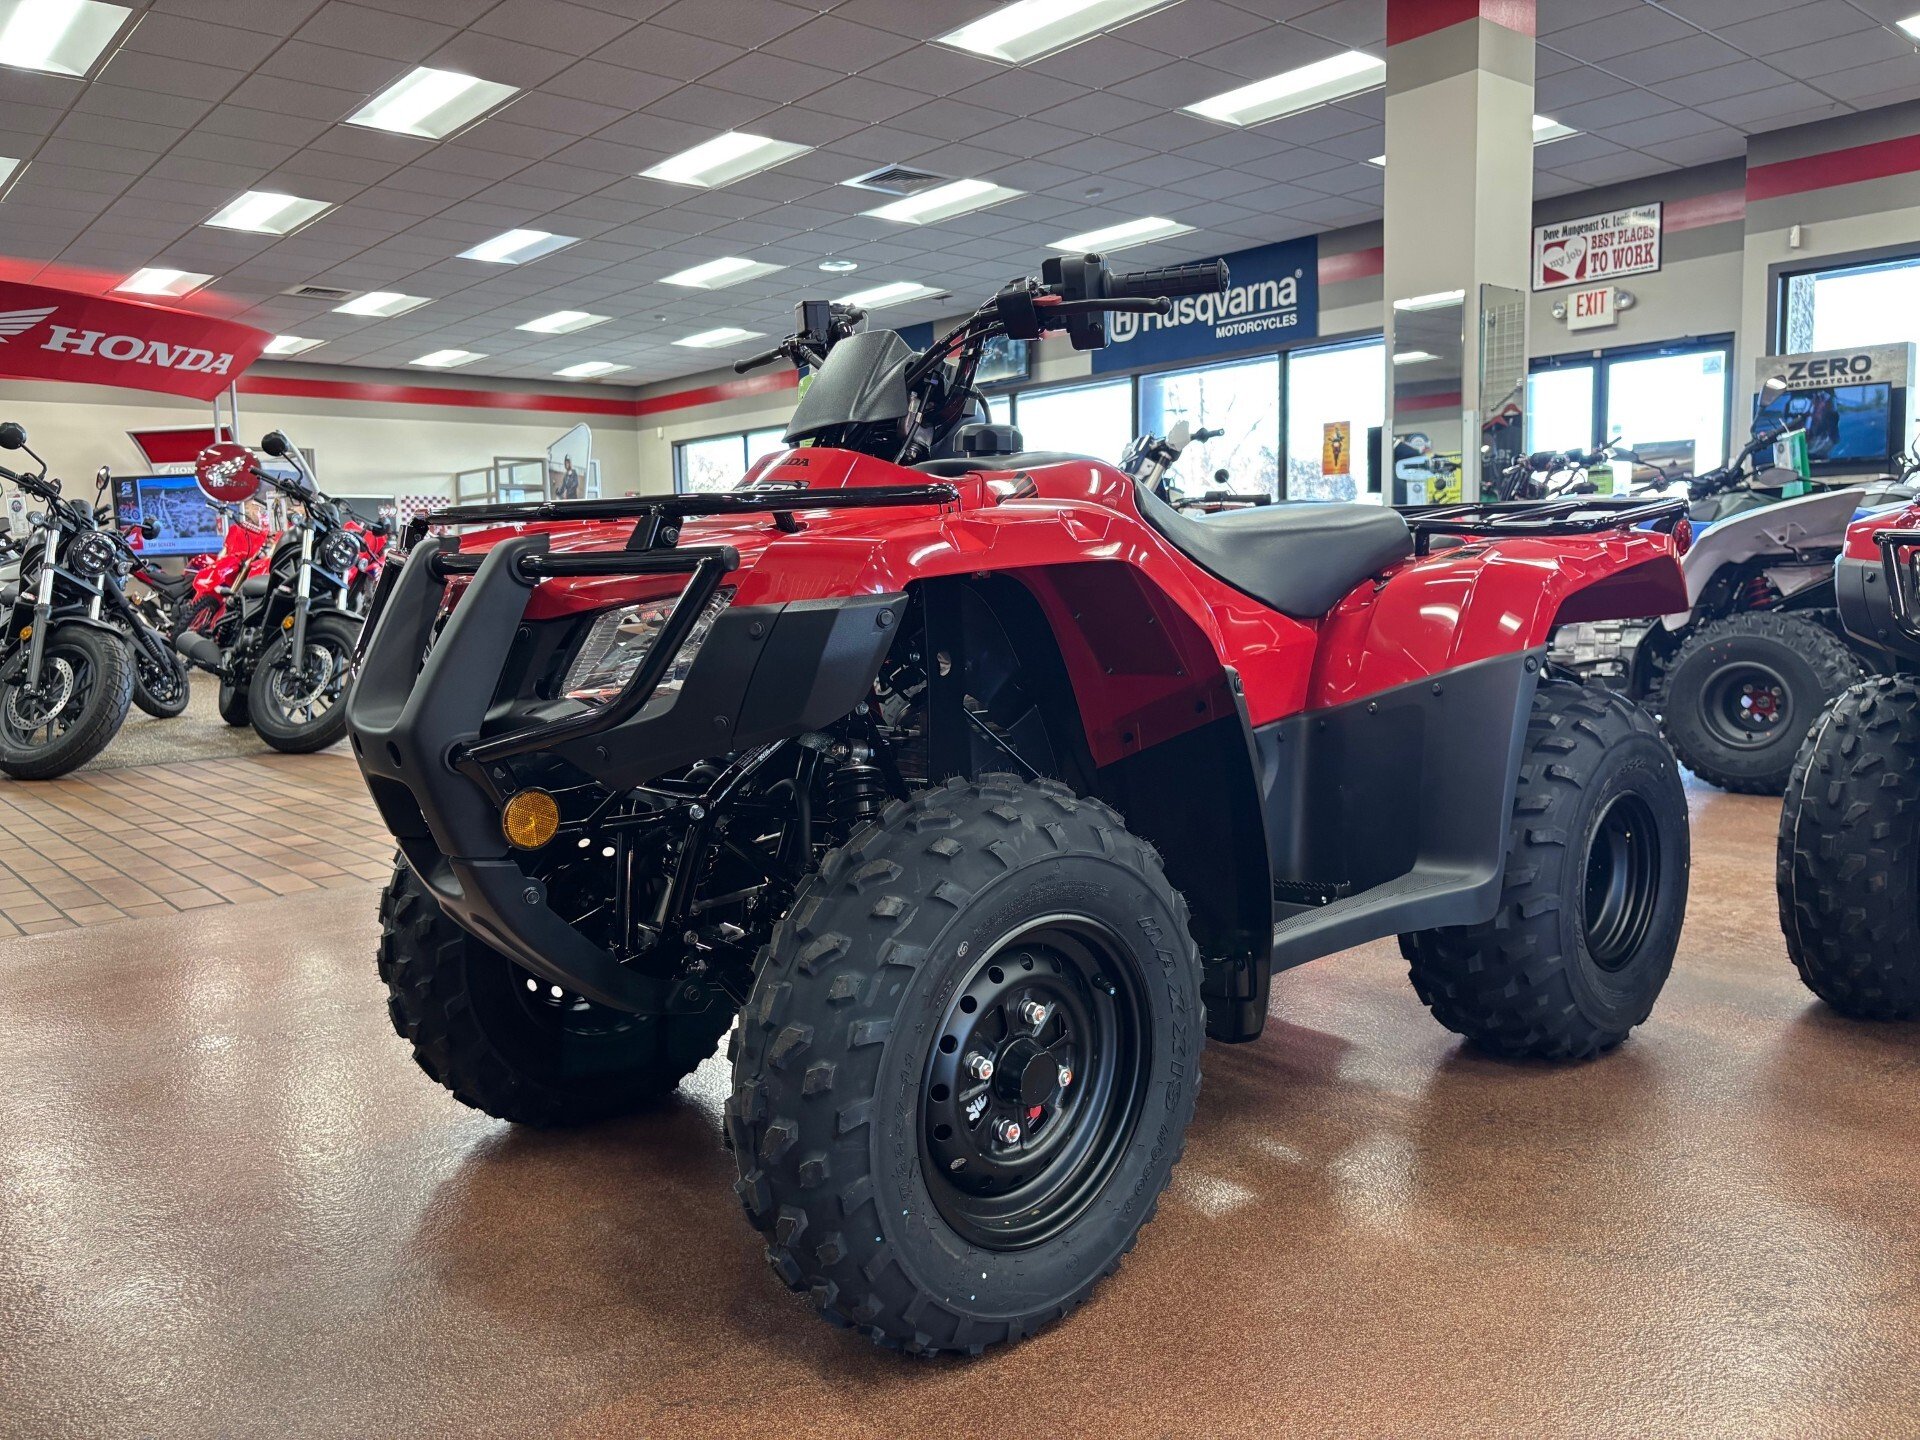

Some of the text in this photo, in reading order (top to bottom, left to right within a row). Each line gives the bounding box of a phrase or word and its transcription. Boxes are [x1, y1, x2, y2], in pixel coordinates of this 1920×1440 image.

[1543, 229, 1560, 241] Dave
[1591, 225, 1655, 250] BEST PLACES
[1549, 255, 1565, 268] my
[1591, 250, 1608, 273] TO
[1612, 242, 1655, 270] WORK
[1576, 290, 1607, 318] EXIT
[1216, 313, 1298, 339] MOTORCYCLES
[40, 324, 234, 375] HONDA
[1788, 355, 1872, 381] ZERO
[1787, 375, 1866, 389] MOTORCYCLES
